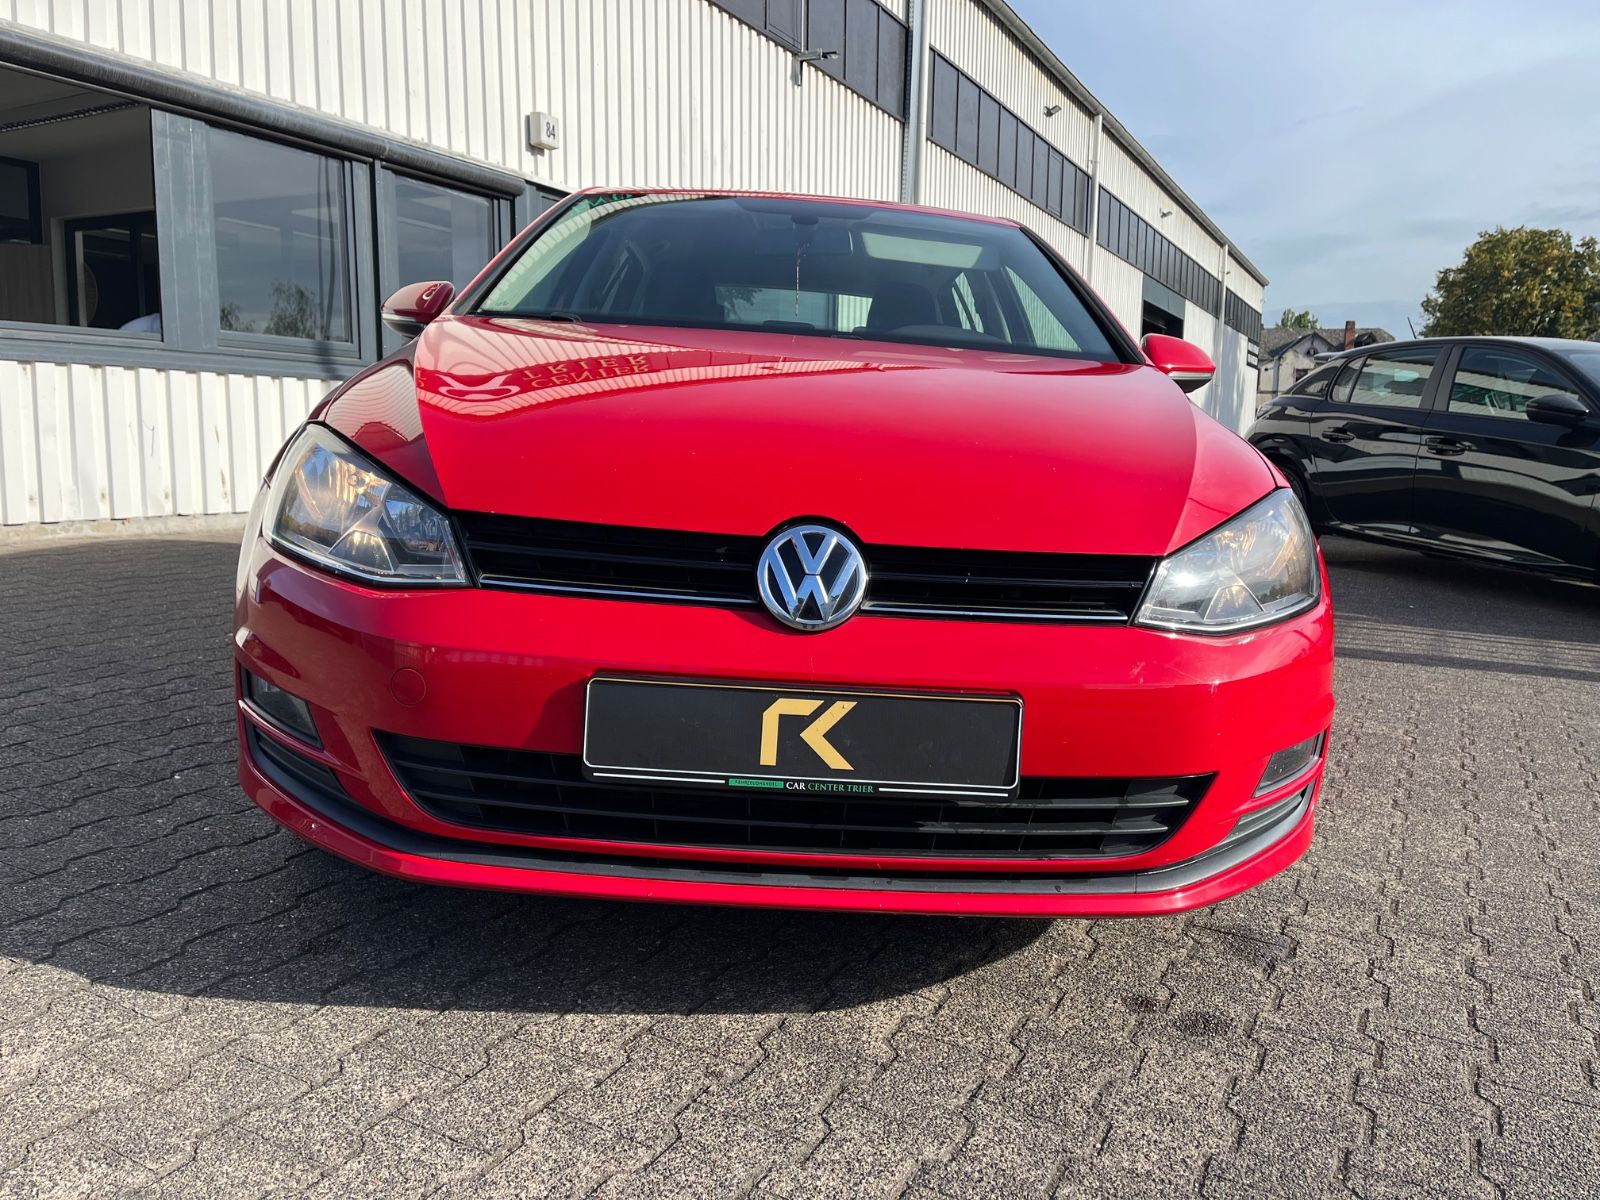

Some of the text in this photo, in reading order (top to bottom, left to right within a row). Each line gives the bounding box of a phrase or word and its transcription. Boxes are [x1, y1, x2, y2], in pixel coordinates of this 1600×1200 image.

[545, 121, 556, 140] 84
[760, 527, 866, 627] VW
[786, 781, 806, 790] CAR
[808, 783, 845, 792] CENTER
[847, 784, 874, 793] TRIER
